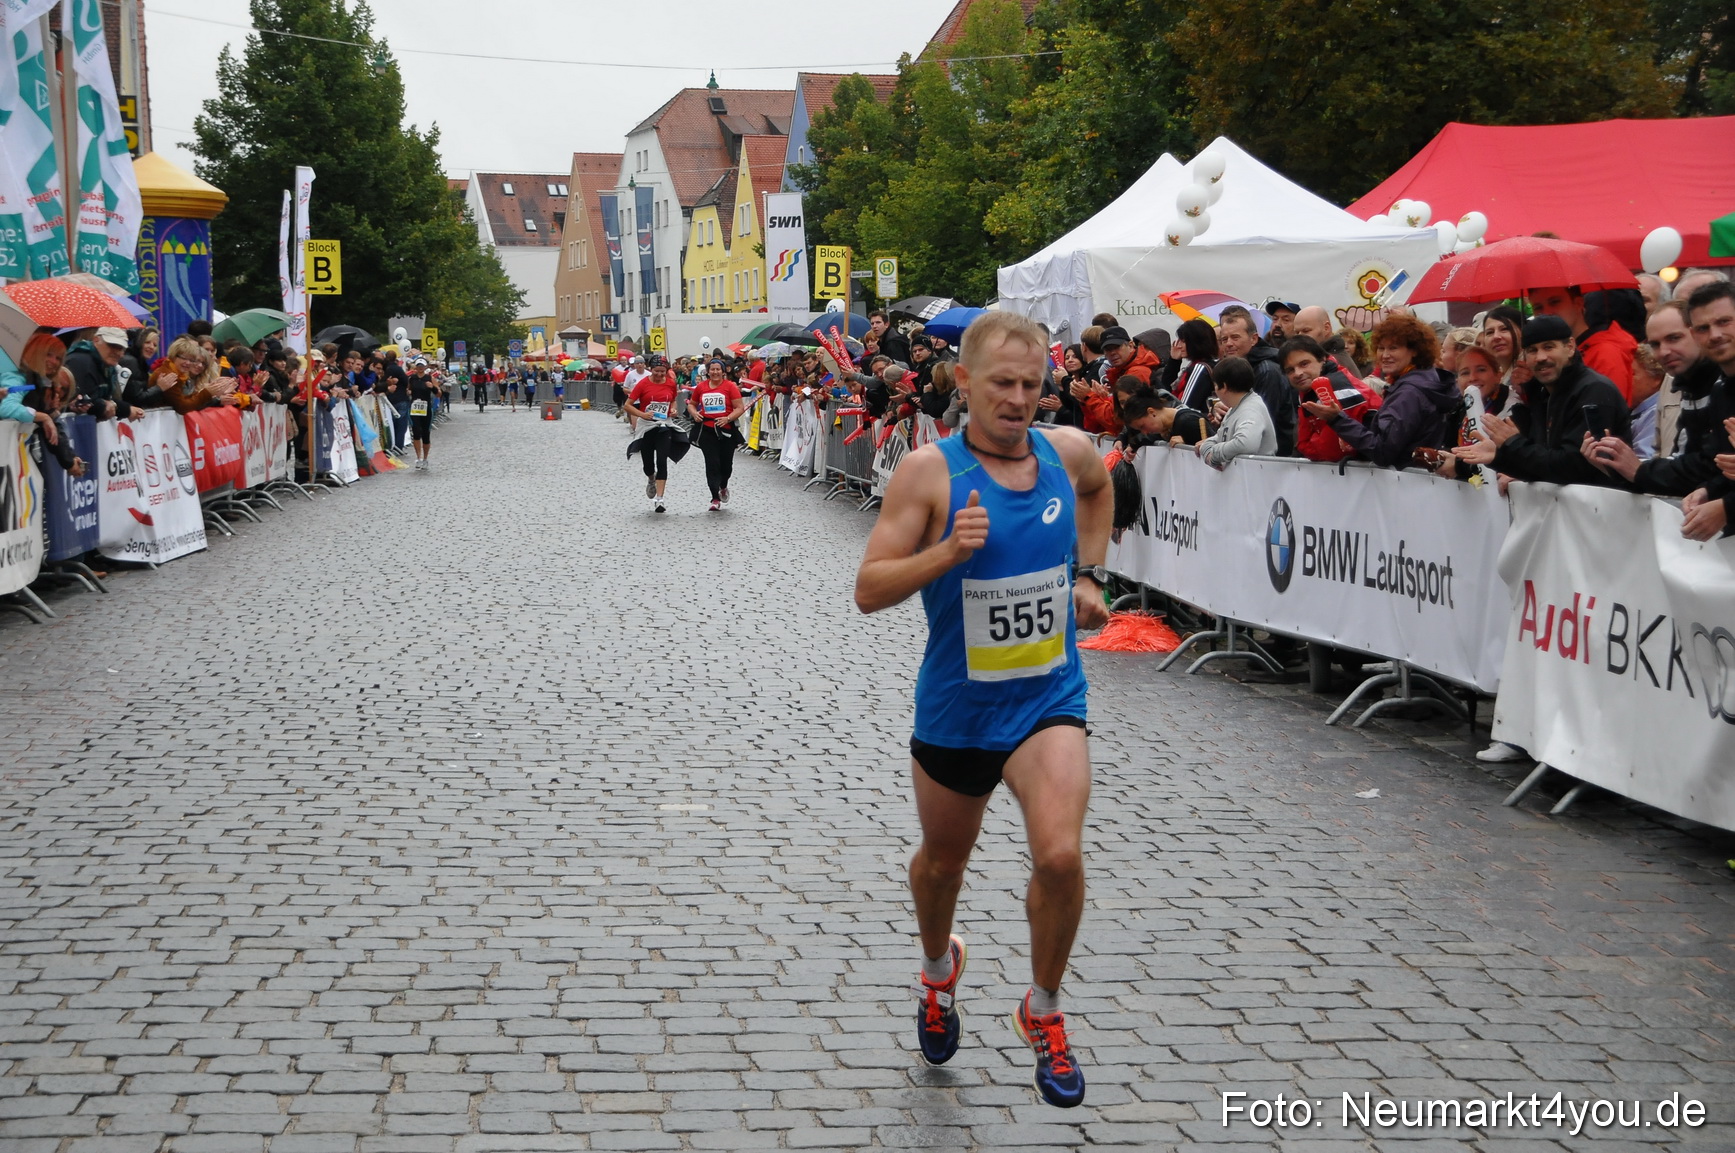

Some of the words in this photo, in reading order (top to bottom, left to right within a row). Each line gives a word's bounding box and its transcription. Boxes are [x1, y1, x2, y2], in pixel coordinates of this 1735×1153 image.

[308, 242, 337, 253] Block
[820, 248, 847, 259] Block
[314, 256, 332, 282] B
[824, 262, 841, 287] B
[426, 335, 434, 347] C
[654, 334, 662, 346] C
[609, 345, 616, 355] D
[704, 397, 723, 407] 2276
[1302, 524, 1359, 584] BMW
[1364, 533, 1454, 613] Laufsport
[964, 589, 1003, 600] PARTL
[1005, 580, 1054, 598] Neumarkt
[988, 596, 1053, 642] 555
[1518, 579, 1596, 665] Audi
